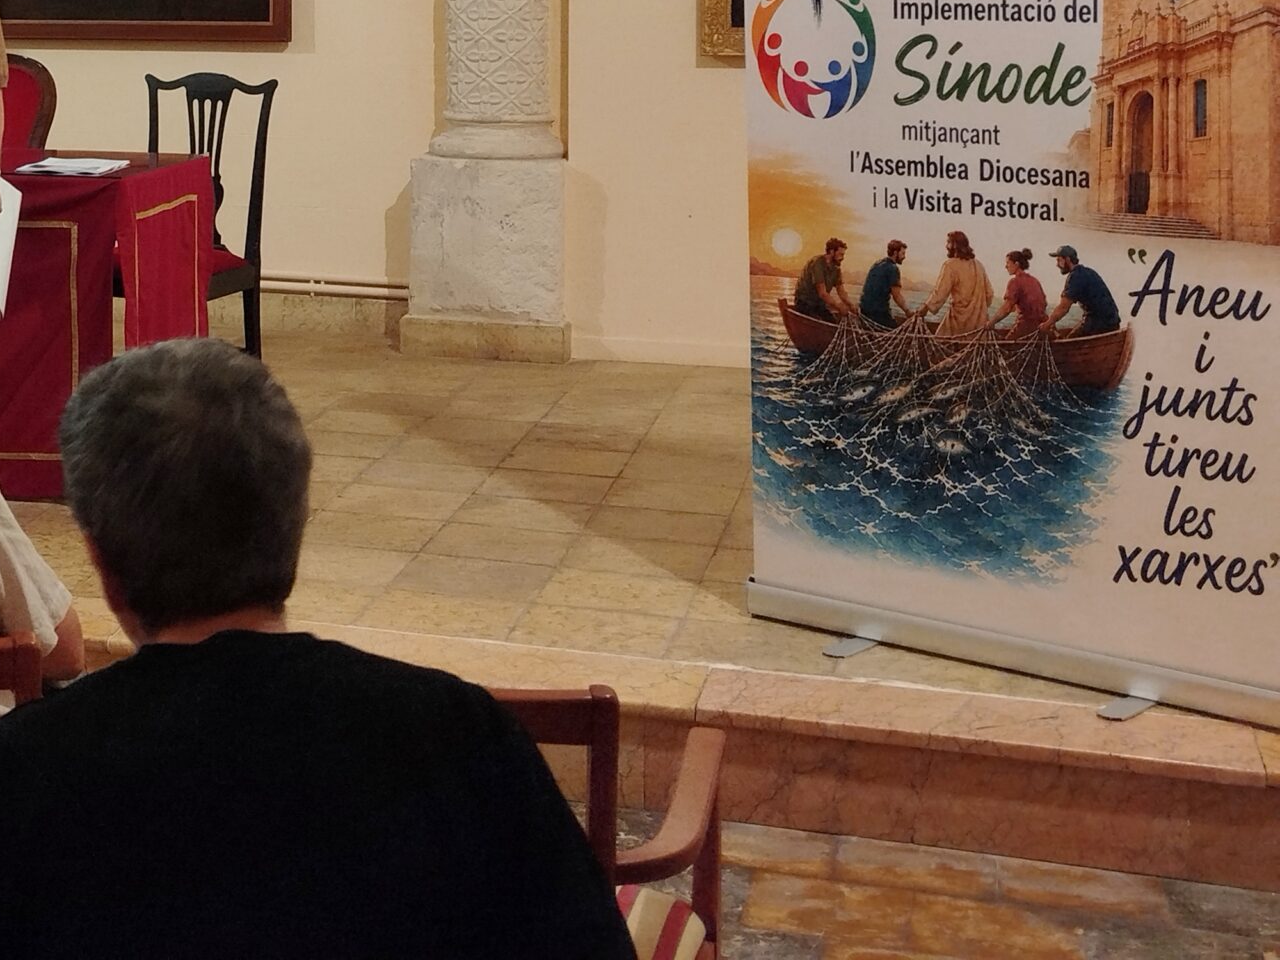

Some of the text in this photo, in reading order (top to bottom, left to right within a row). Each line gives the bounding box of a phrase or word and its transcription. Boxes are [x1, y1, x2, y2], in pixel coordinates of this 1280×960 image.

[893, 33, 1092, 107] Sínode
[901, 119, 1001, 147] mitjançant
[979, 158, 1091, 190] Diocesana
[872, 186, 1066, 223] i la Visita Pastoral.
[1194, 331, 1216, 374] i
[1122, 371, 1258, 440] junts
[1142, 431, 1257, 484] tireu
[1163, 485, 1216, 541] les
